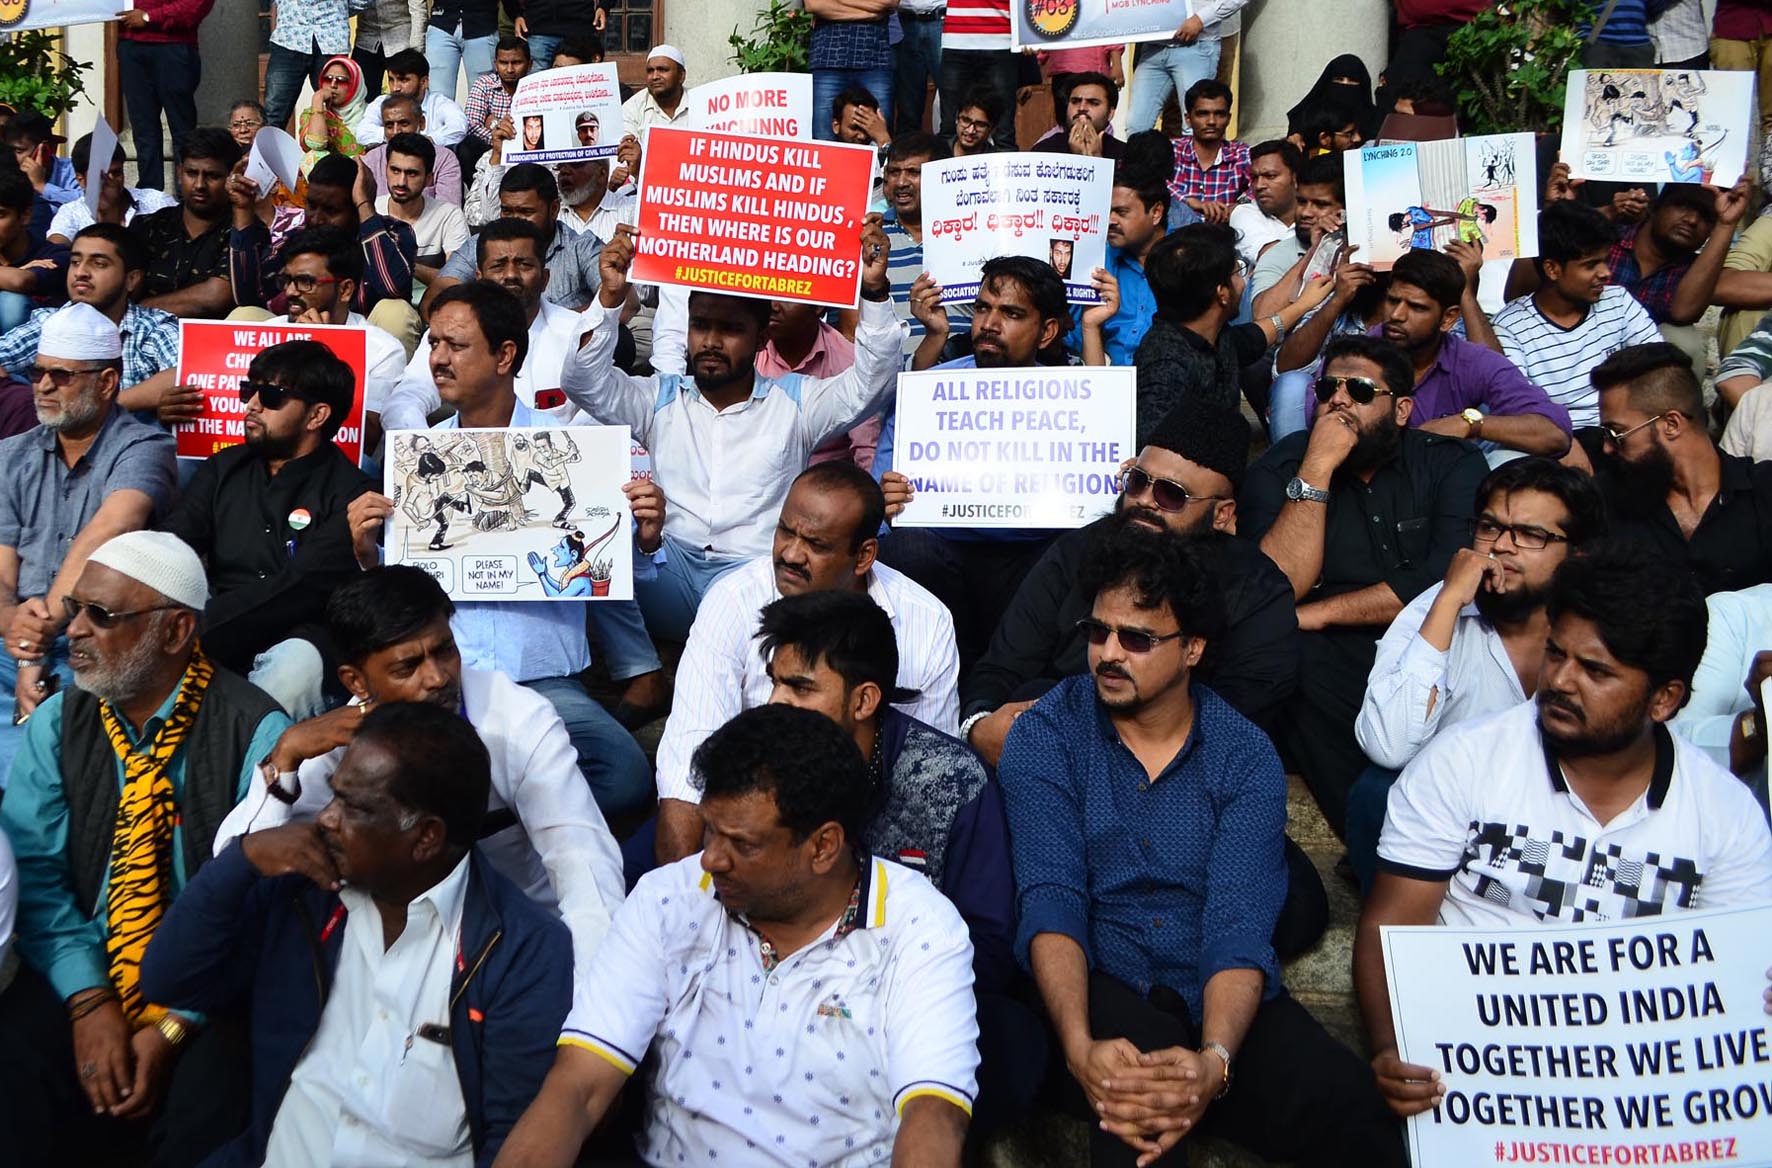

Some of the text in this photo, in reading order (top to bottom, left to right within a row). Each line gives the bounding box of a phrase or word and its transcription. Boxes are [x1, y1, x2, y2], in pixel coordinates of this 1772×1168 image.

[708, 90, 788, 115] NO MORE
[690, 138, 822, 169] IF HINDUS KILL
[1364, 148, 1398, 162] LYNCHING
[680, 162, 826, 196] MUSLIMS AND IF
[941, 166, 968, 185] ಗುಂಪು
[646, 186, 727, 212] MUSLIMS
[732, 195, 768, 216] KILL
[773, 200, 844, 224] HINDUS
[658, 212, 836, 250] THEN WHERE IS OUR
[638, 237, 856, 278] MOTHERLAND HEADING?
[675, 266, 812, 295] #JUSTICEFORTABREZ
[1072, 288, 1096, 299] RIGHTS
[234, 330, 256, 346] WE
[258, 332, 282, 347] ALL
[187, 374, 216, 390] ONE
[932, 379, 1092, 401] ALL RELIGIONS
[199, 418, 222, 435] THE
[936, 410, 1086, 434] TEACH PEACE,
[910, 441, 1120, 462] DO NOT KILL IN THE
[910, 473, 972, 494] NAME
[980, 473, 1009, 494] OF
[468, 570, 514, 580] NOT IN MY
[476, 560, 503, 570] PLEASE
[476, 580, 504, 590] NAME!
[1462, 928, 1715, 976] WE ARE FOR A
[1476, 981, 1726, 1027] UNITED INDIA
[1434, 1028, 1770, 1078] TOGETHER WE LIVE
[1614, 1094, 1674, 1130] WE
[1494, 1137, 1738, 1166] #JUSTICEFORTABREZ
